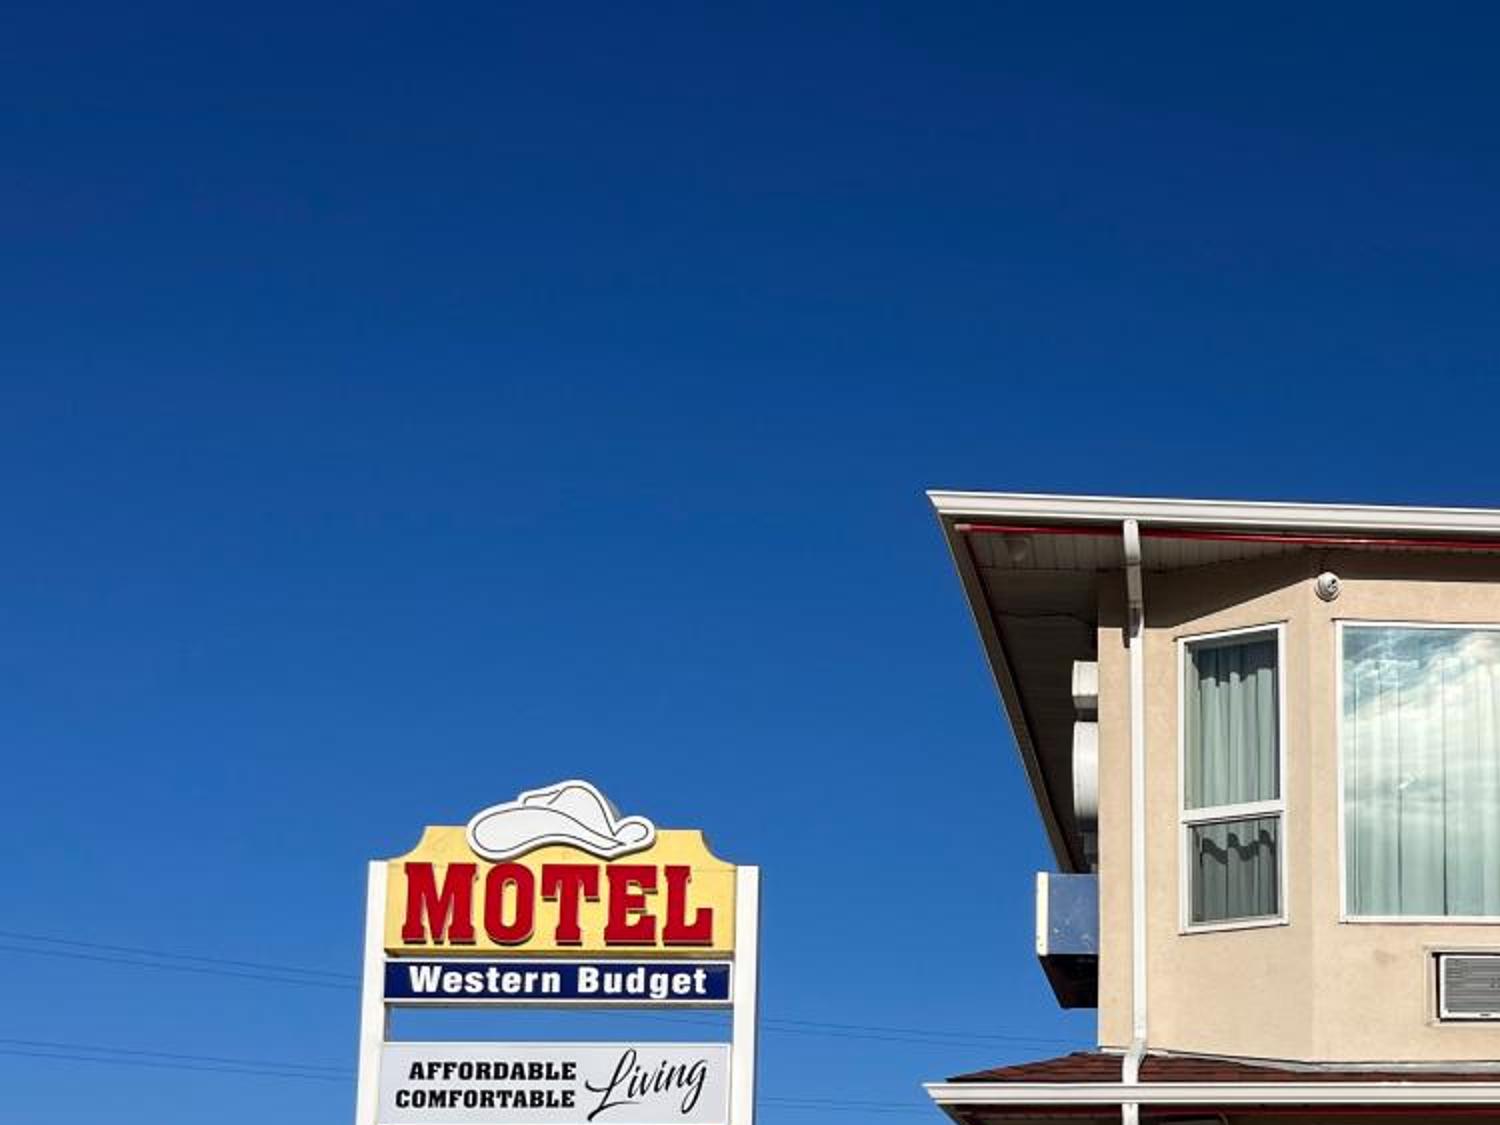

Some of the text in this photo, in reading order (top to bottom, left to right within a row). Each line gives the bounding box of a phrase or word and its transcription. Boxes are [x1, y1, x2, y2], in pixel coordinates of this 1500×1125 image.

[401, 862, 714, 946] MOTEL
[409, 965, 707, 999] Western Budget
[409, 1061, 577, 1081] AFFORDABLE
[584, 1048, 709, 1122] Living
[395, 1089, 576, 1109] COMFORTABLE
